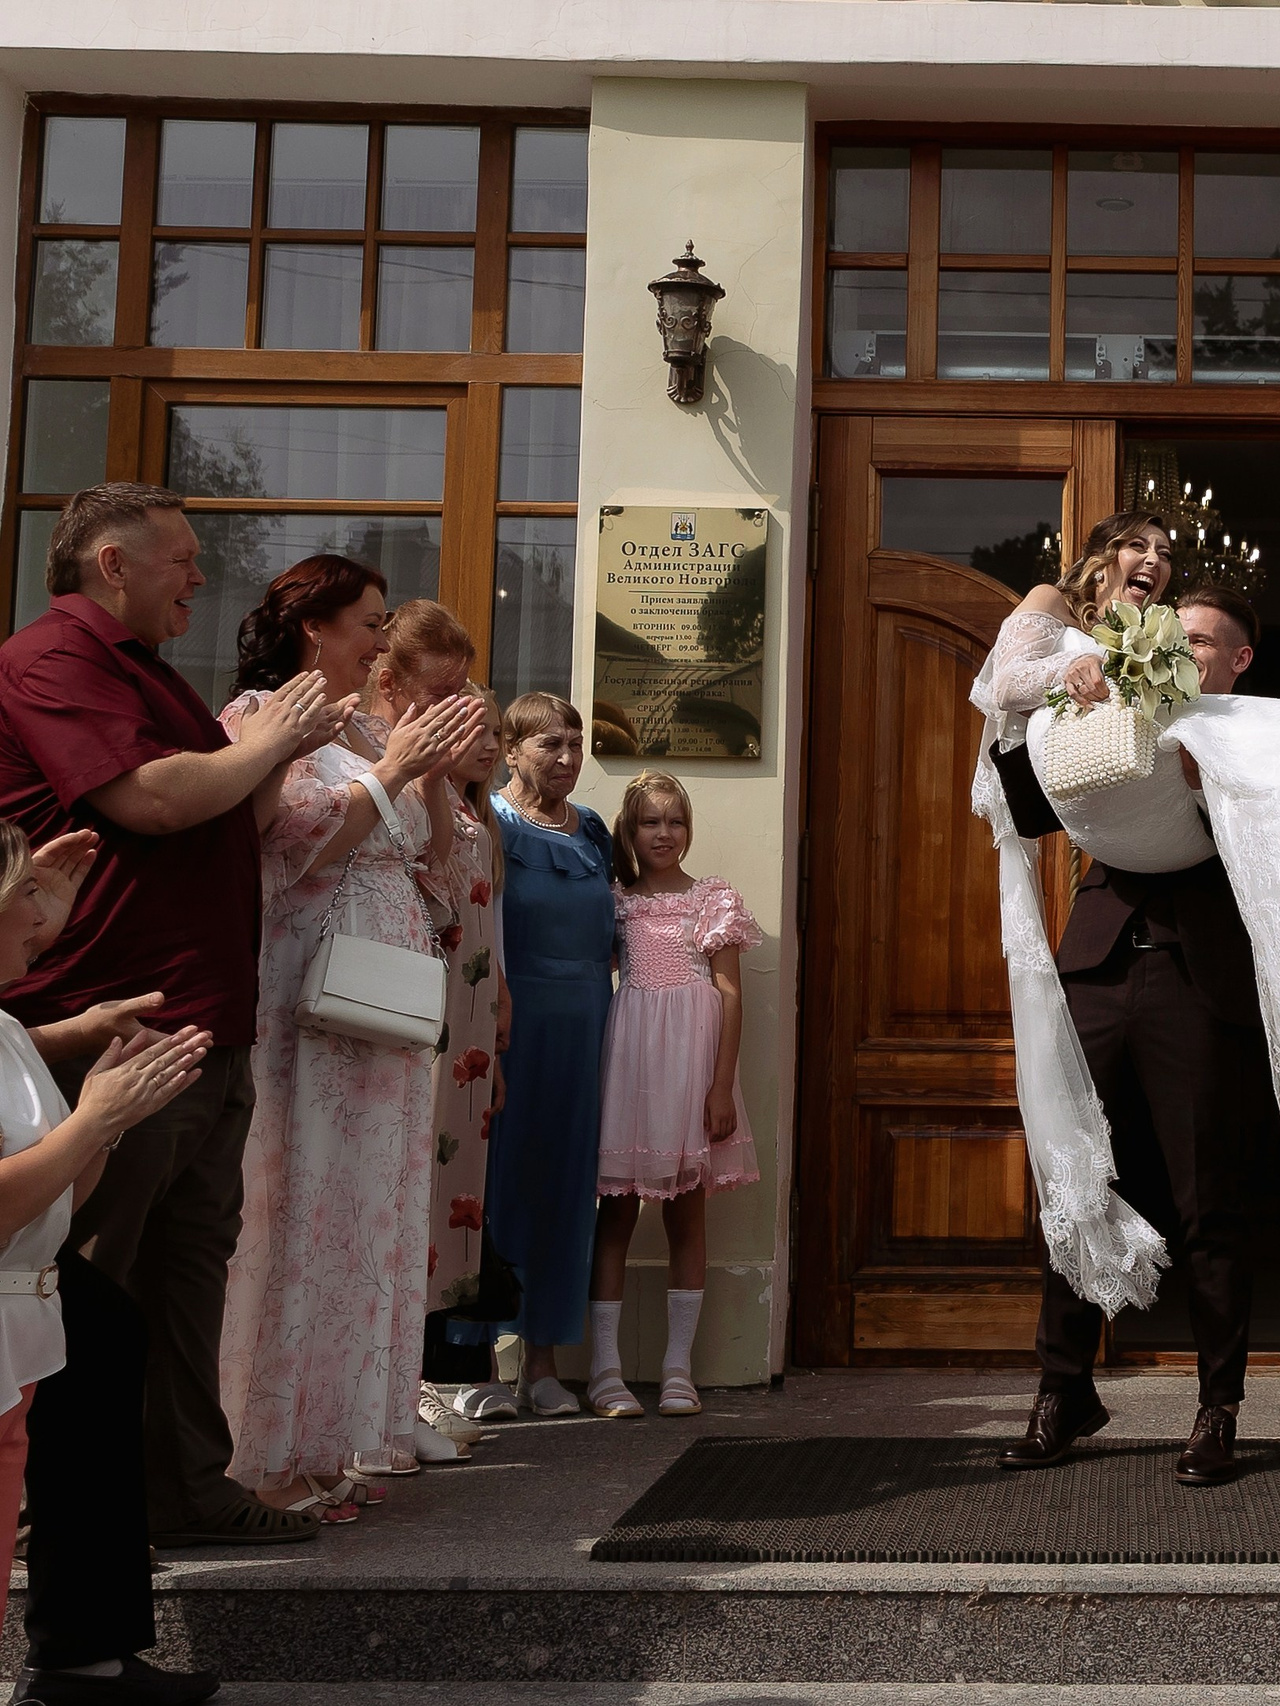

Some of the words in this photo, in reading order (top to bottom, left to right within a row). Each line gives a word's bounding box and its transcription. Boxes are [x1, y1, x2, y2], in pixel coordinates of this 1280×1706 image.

[621, 541, 682, 559] Отдел
[688, 542, 745, 559] ЗАГС
[623, 559, 741, 574] Администрации
[606, 572, 674, 585] Великого
[679, 573, 757, 588] Новгорода
[641, 595, 674, 606] Прием
[638, 607, 700, 616] заключении
[632, 623, 676, 631] ВТОРНИК
[633, 644, 672, 652] ЧЕТВЕРГ
[604, 675, 688, 687] Государственная
[690, 677, 753, 688] регистрация
[637, 705, 666, 713] СРЕДА
[628, 717, 674, 725] ПЯТНИЦА
